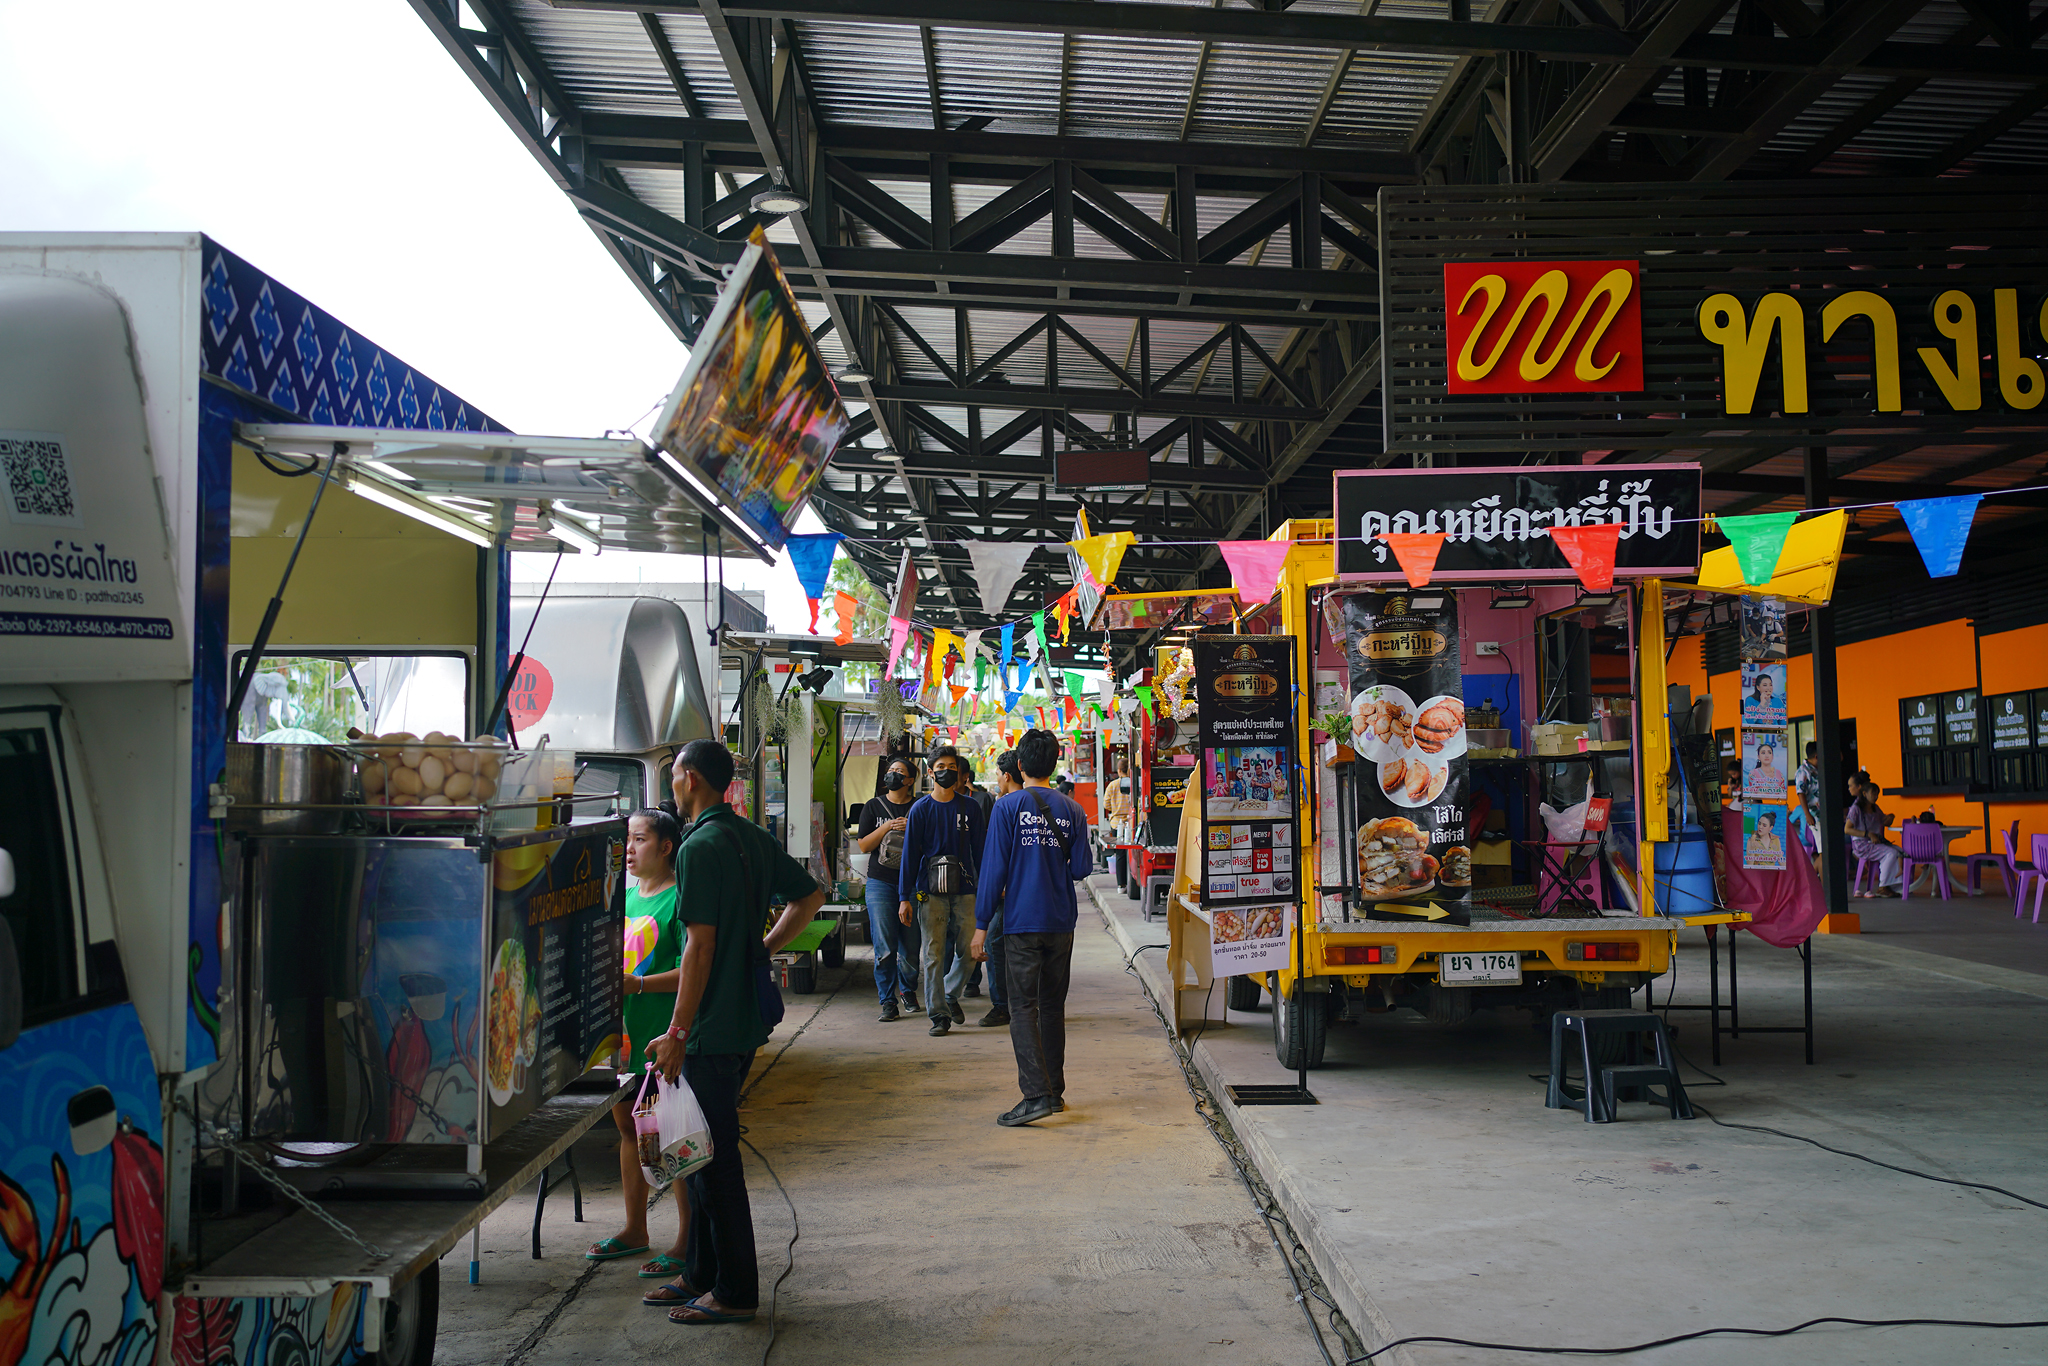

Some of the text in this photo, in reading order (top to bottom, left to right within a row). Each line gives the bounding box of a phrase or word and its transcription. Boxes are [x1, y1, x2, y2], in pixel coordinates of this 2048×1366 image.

[1699, 287, 2048, 414] ทางเ
[0, 540, 137, 583] เตอร์ผัดไทย
[44, 586, 64, 600] Line
[67, 588, 77, 601] ID
[85, 590, 144, 604] padthai2345
[1432, 804, 1463, 824] ไส้ไก่
[1431, 827, 1465, 844] เลิศรส
[1241, 877, 1260, 887] true
[1251, 886, 1270, 894] visions
[1250, 950, 1267, 959] 20-50
[1451, 955, 1515, 970] ยจ 1764
